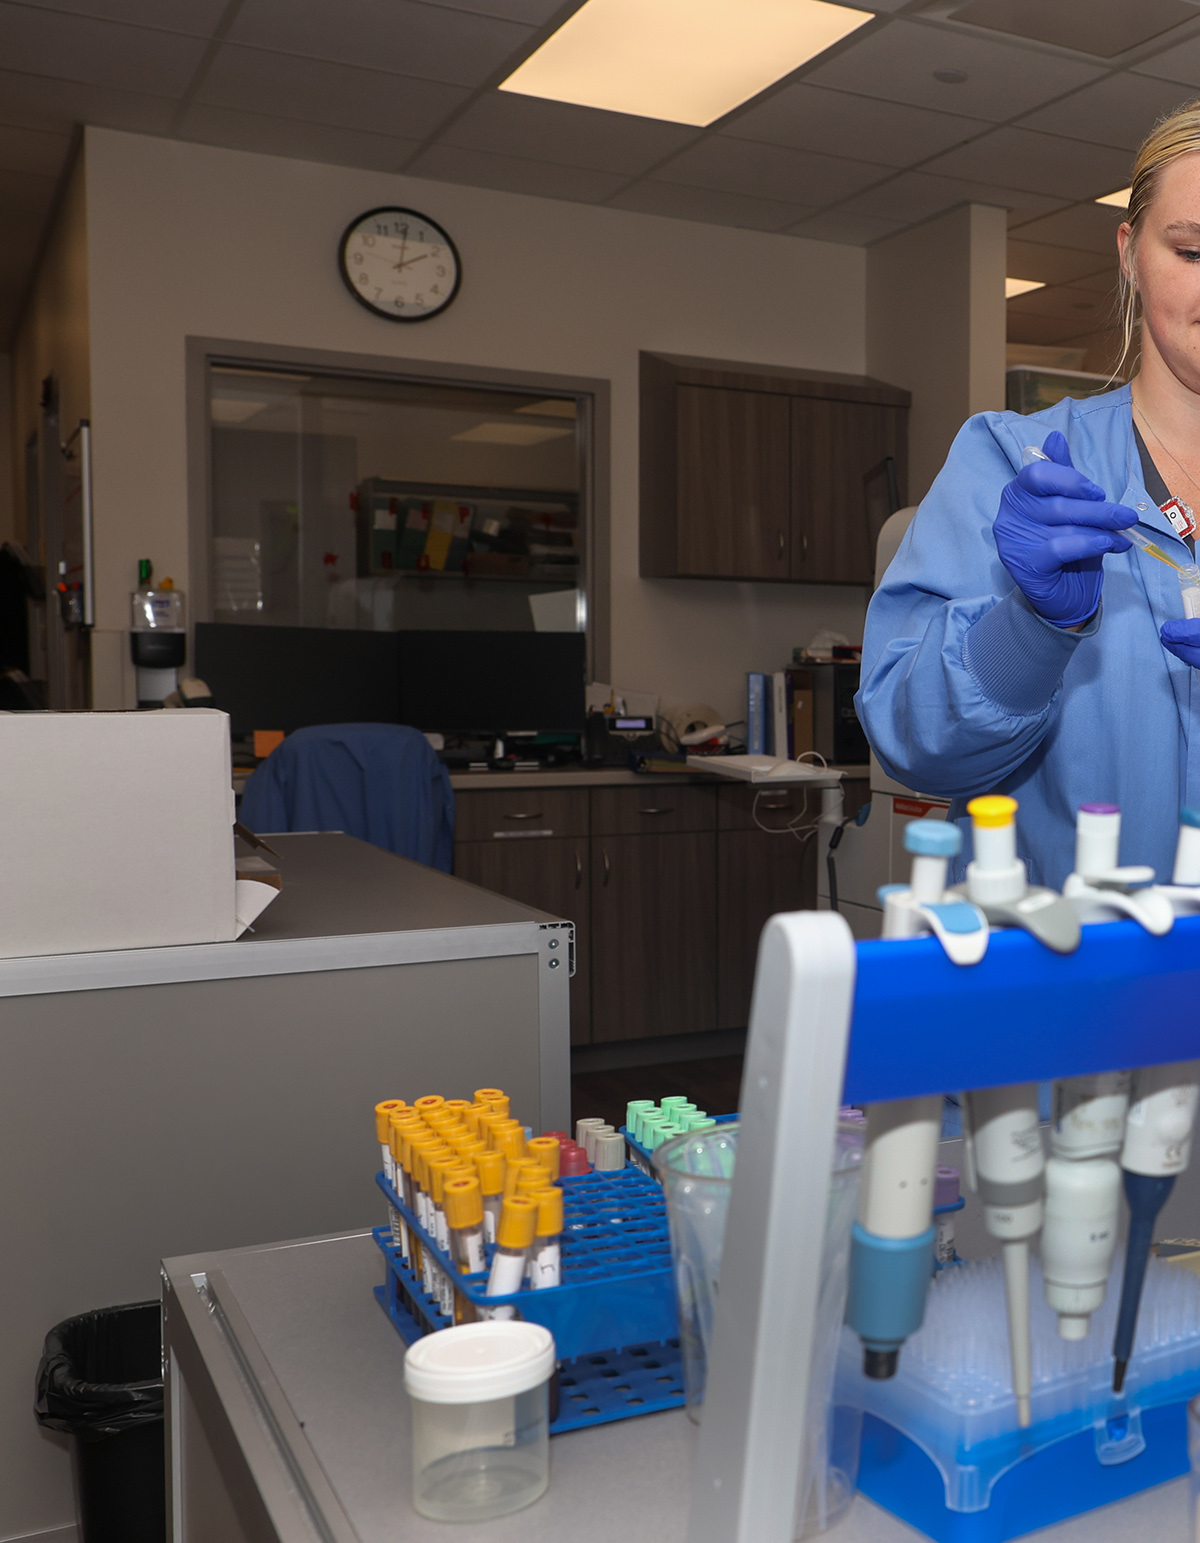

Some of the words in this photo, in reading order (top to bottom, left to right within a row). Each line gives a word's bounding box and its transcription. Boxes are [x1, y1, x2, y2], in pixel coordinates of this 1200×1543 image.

[377, 225, 388, 236] 11
[394, 222, 409, 235] 12
[362, 235, 376, 248] 10
[418, 231, 424, 242] 1
[430, 246, 440, 258] 2
[353, 252, 364, 265] 9
[436, 265, 446, 278] 3
[359, 272, 369, 285] 8
[375, 287, 384, 299] 7
[430, 284, 439, 294] 4
[394, 296, 405, 308] 6
[415, 294, 424, 306] 5
